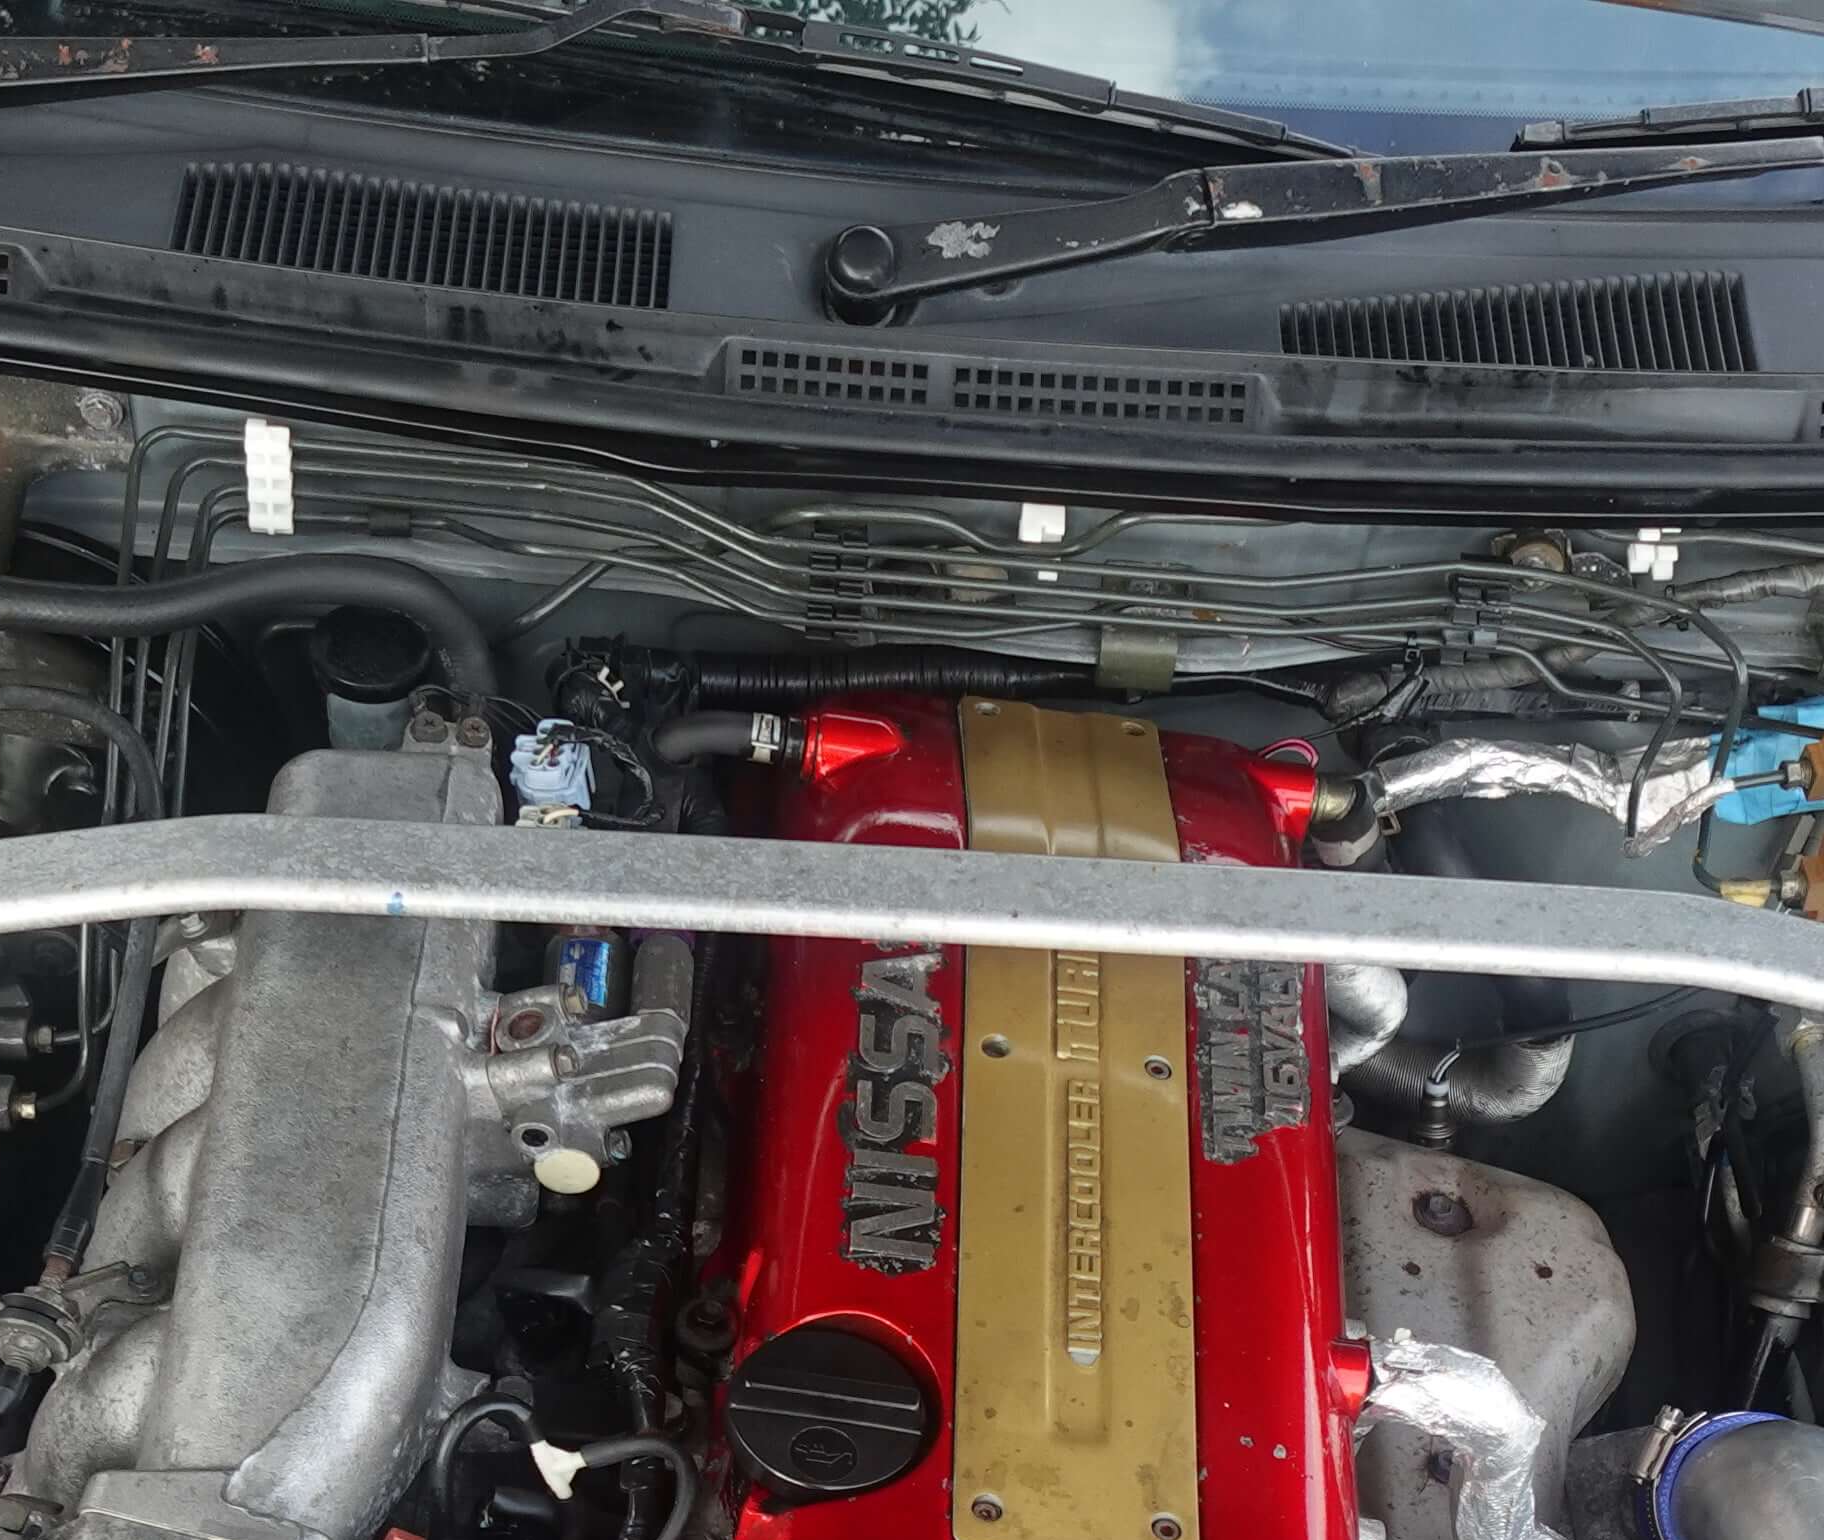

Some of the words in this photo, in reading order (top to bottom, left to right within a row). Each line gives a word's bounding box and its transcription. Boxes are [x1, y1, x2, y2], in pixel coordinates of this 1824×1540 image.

[849, 942, 943, 1262] NISSA
[1056, 952, 1101, 1061] TUR
[1067, 1080, 1103, 1353] INTERCOOLER
